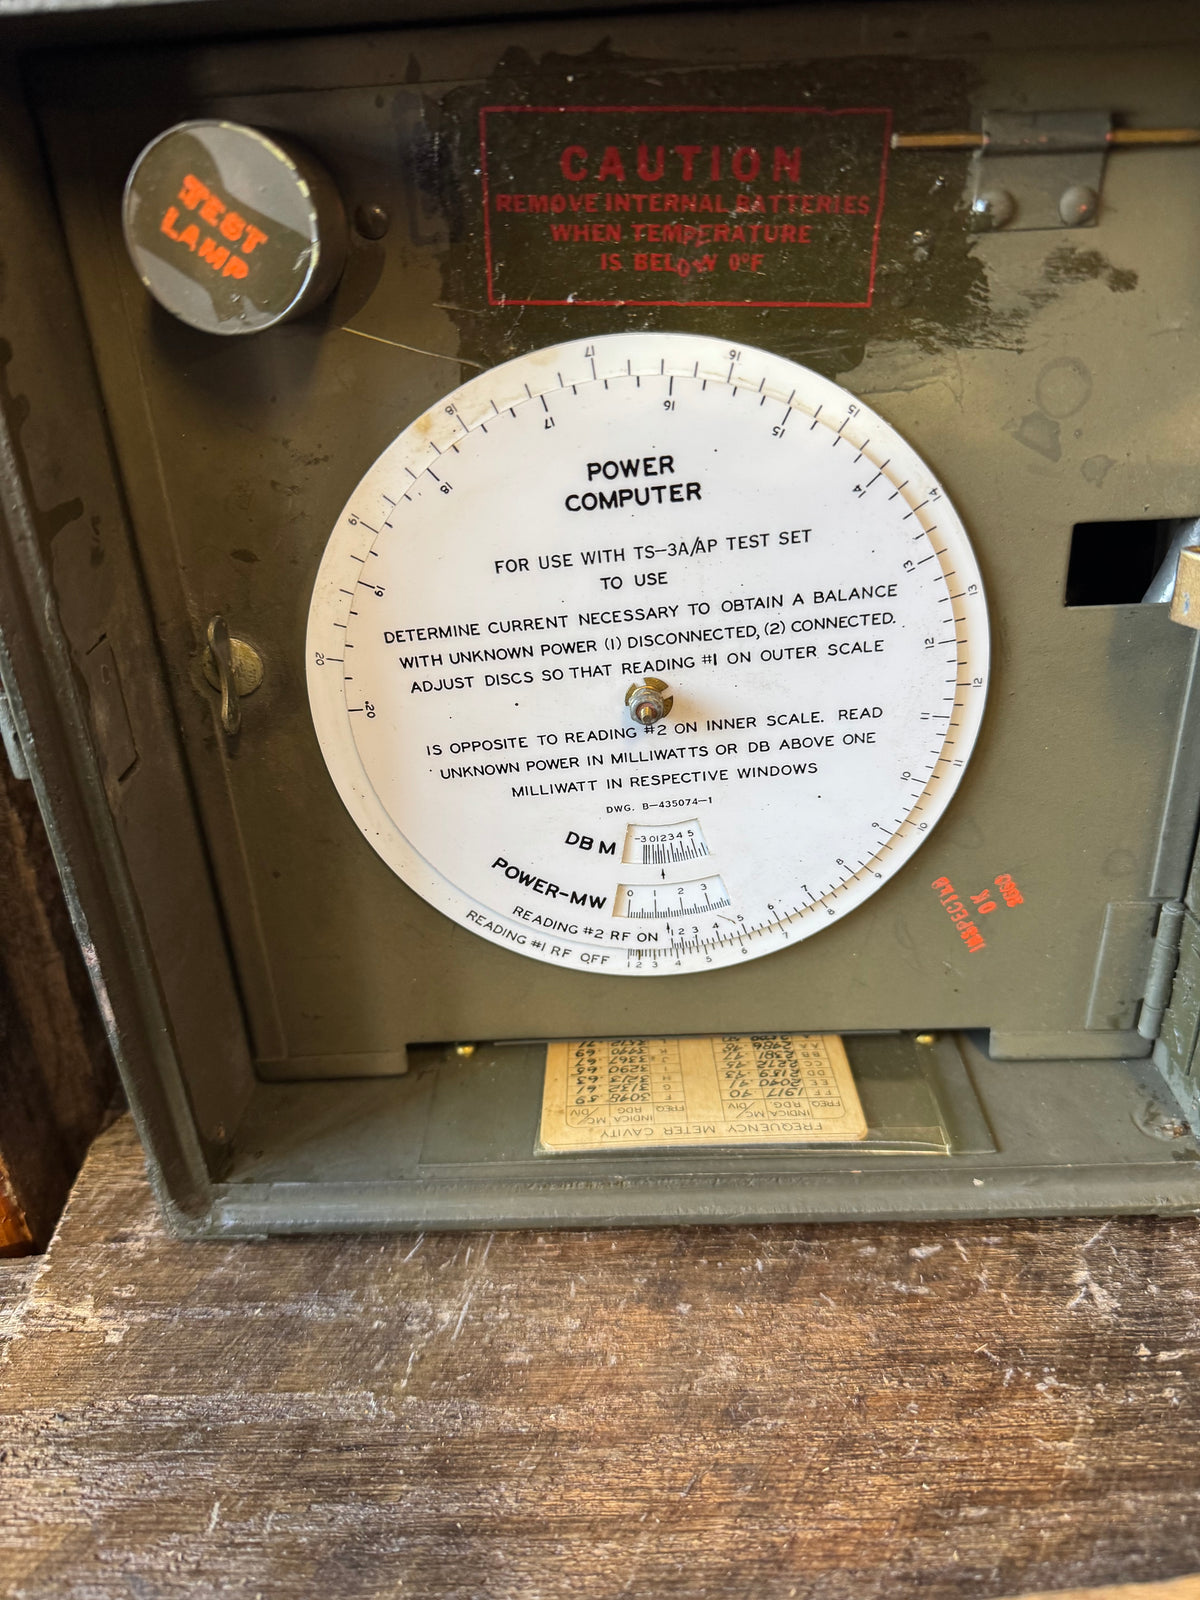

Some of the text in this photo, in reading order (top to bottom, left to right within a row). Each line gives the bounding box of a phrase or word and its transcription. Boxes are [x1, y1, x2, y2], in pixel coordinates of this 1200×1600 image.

[560, 145, 801, 182] CAUTION
[178, 174, 269, 254] TEST
[496, 194, 870, 214] REMOVE INTERNAL BATTERIES
[160, 206, 249, 279] LAMP
[550, 223, 812, 247] WHEN TEMPERATURE
[600, 253, 622, 271] IS
[634, 253, 719, 277] BELOW
[587, 455, 675, 481] POWER
[565, 482, 702, 512] COMPUTER
[495, 529, 812, 574] FOR USE WITH TS-3A/AP TEST SET
[600, 572, 668, 590] TO USE
[384, 584, 897, 644] DETERMINE CURRENT NECESSARY TO OBTAIN A BALANCE
[399, 654, 443, 669] WITH
[449, 645, 534, 665] UNKNOWN
[541, 640, 597, 656] POWER
[627, 626, 760, 649] DISCONNECTED,
[764, 620, 785, 636] (2)
[791, 612, 896, 632] CONNECTED.
[411, 676, 474, 693] ADJUST
[485, 671, 534, 686] DISCS
[542, 669, 564, 681] SO
[569, 664, 612, 679] THAT
[622, 657, 695, 675] READING
[727, 651, 751, 664] ON
[760, 646, 817, 662] OUTER
[828, 640, 884, 656] SCALE
[426, 707, 883, 756] IS OPPOSITE TO READING #2 ON INNER SCALE. READ
[440, 732, 876, 779] UNKNOWN POWER IN MILLIWATTS OR DB ABOVE ONE
[512, 763, 818, 797] MILLIWATT IN RESPECTIVE WINDOWS
[606, 804, 634, 813] DWG.
[701, 883, 708, 891] 3
[970, 889, 996, 914] OK
[512, 905, 658, 942] READING #2 RF ON
[931, 876, 986, 953] INSPECTED
[465, 909, 527, 945] READING
[551, 946, 572, 957] RF
[580, 953, 610, 964] OFF
[600, 1122, 823, 1139] FREQUENCY METER CAVITY
